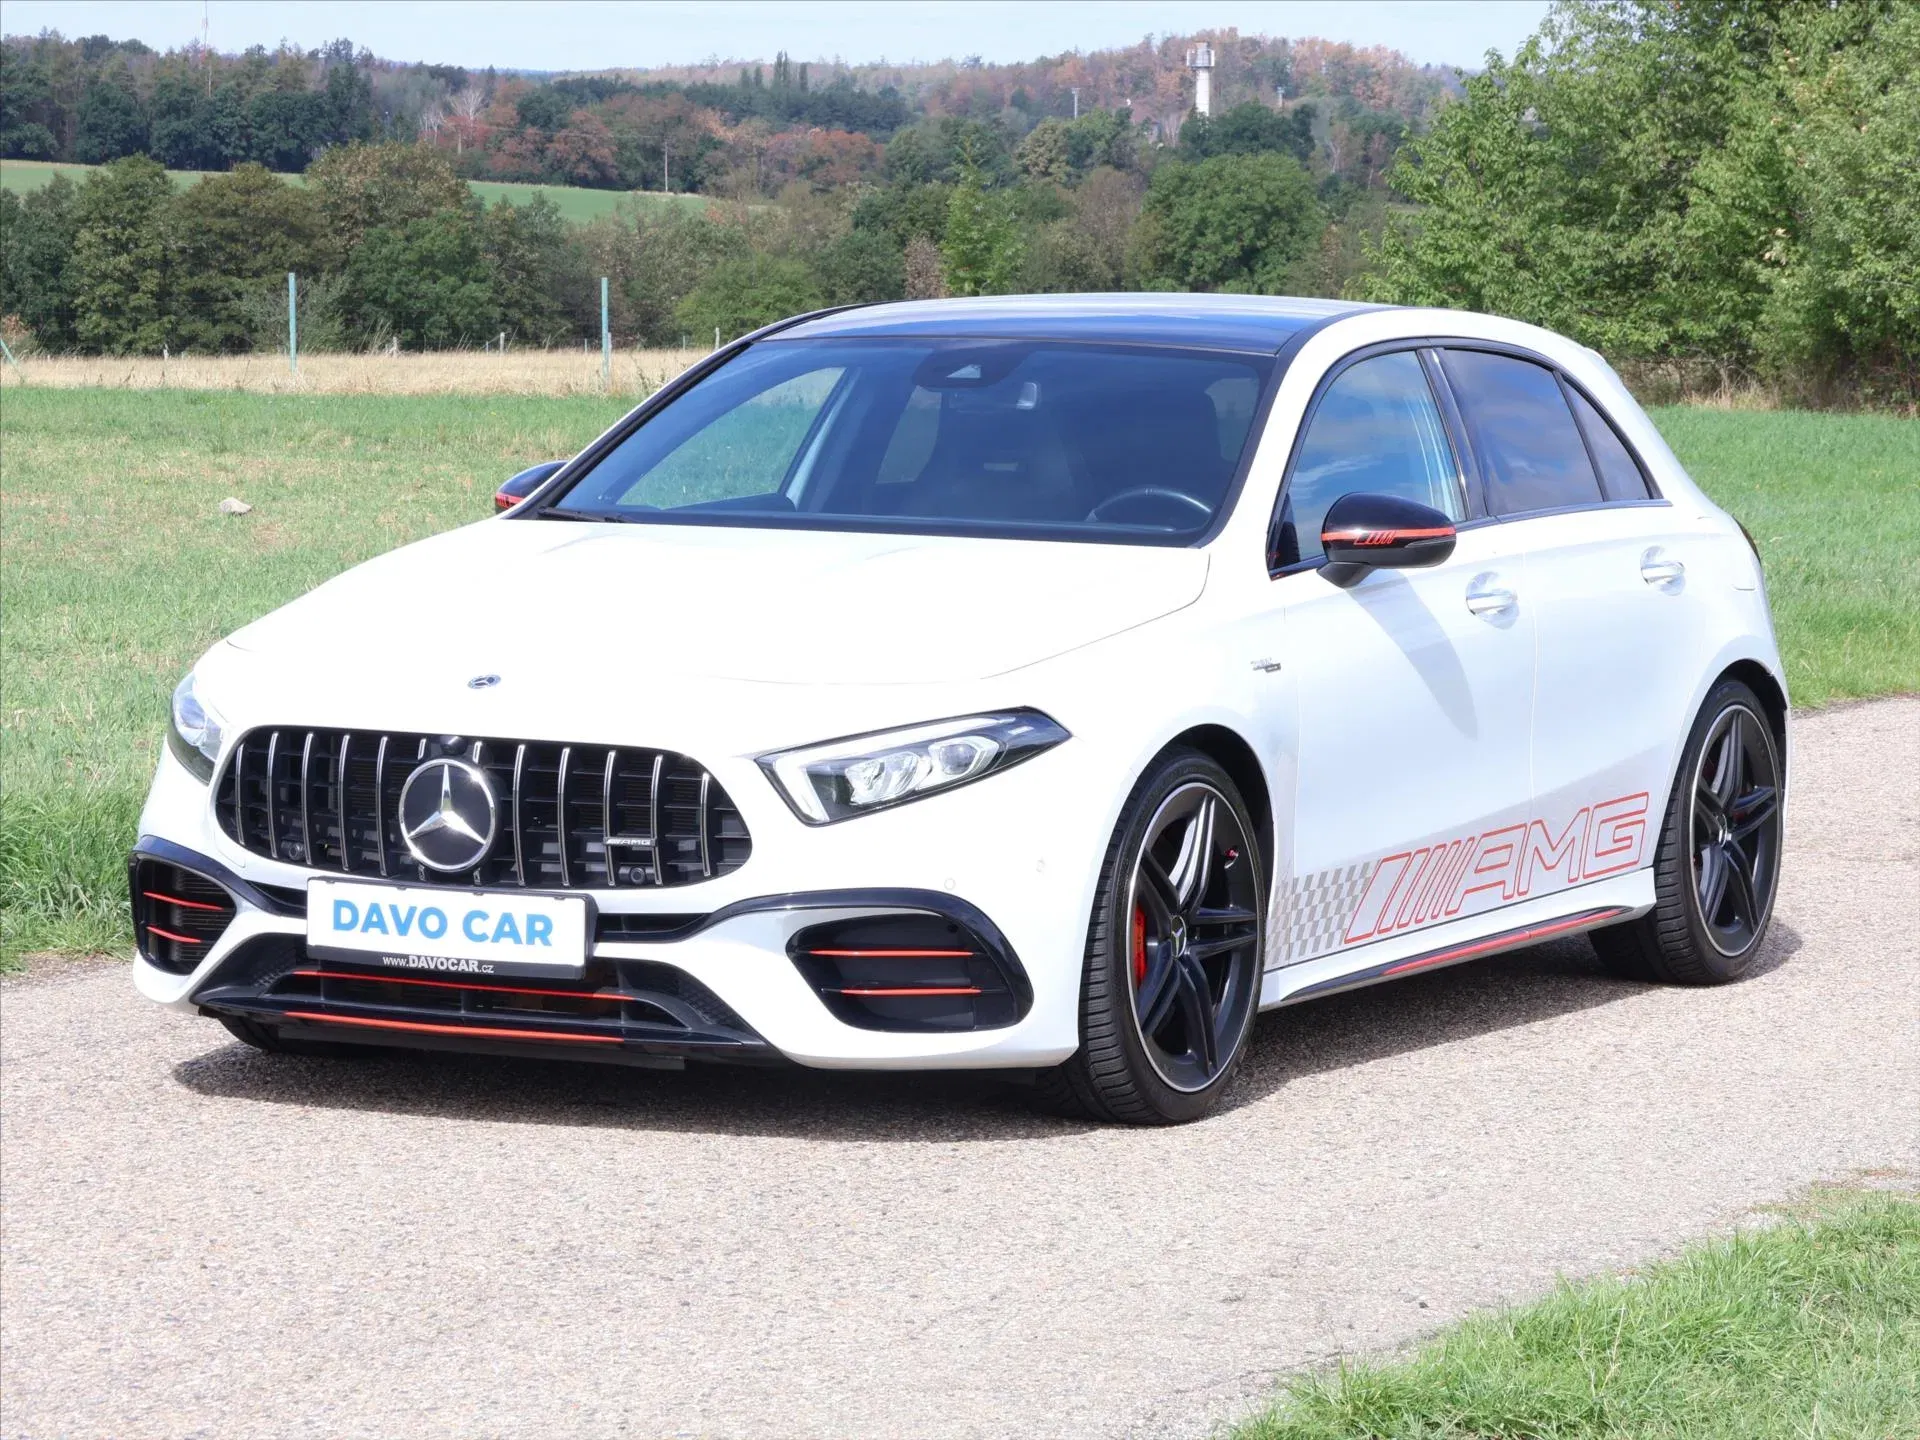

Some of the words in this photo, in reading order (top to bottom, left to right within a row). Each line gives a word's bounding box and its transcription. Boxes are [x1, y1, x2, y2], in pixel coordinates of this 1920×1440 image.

[1446, 792, 1649, 914] AMG
[333, 900, 448, 939] DAVO
[462, 910, 553, 946] CAR
[382, 955, 494, 974] www.DAVOCAR.cz
